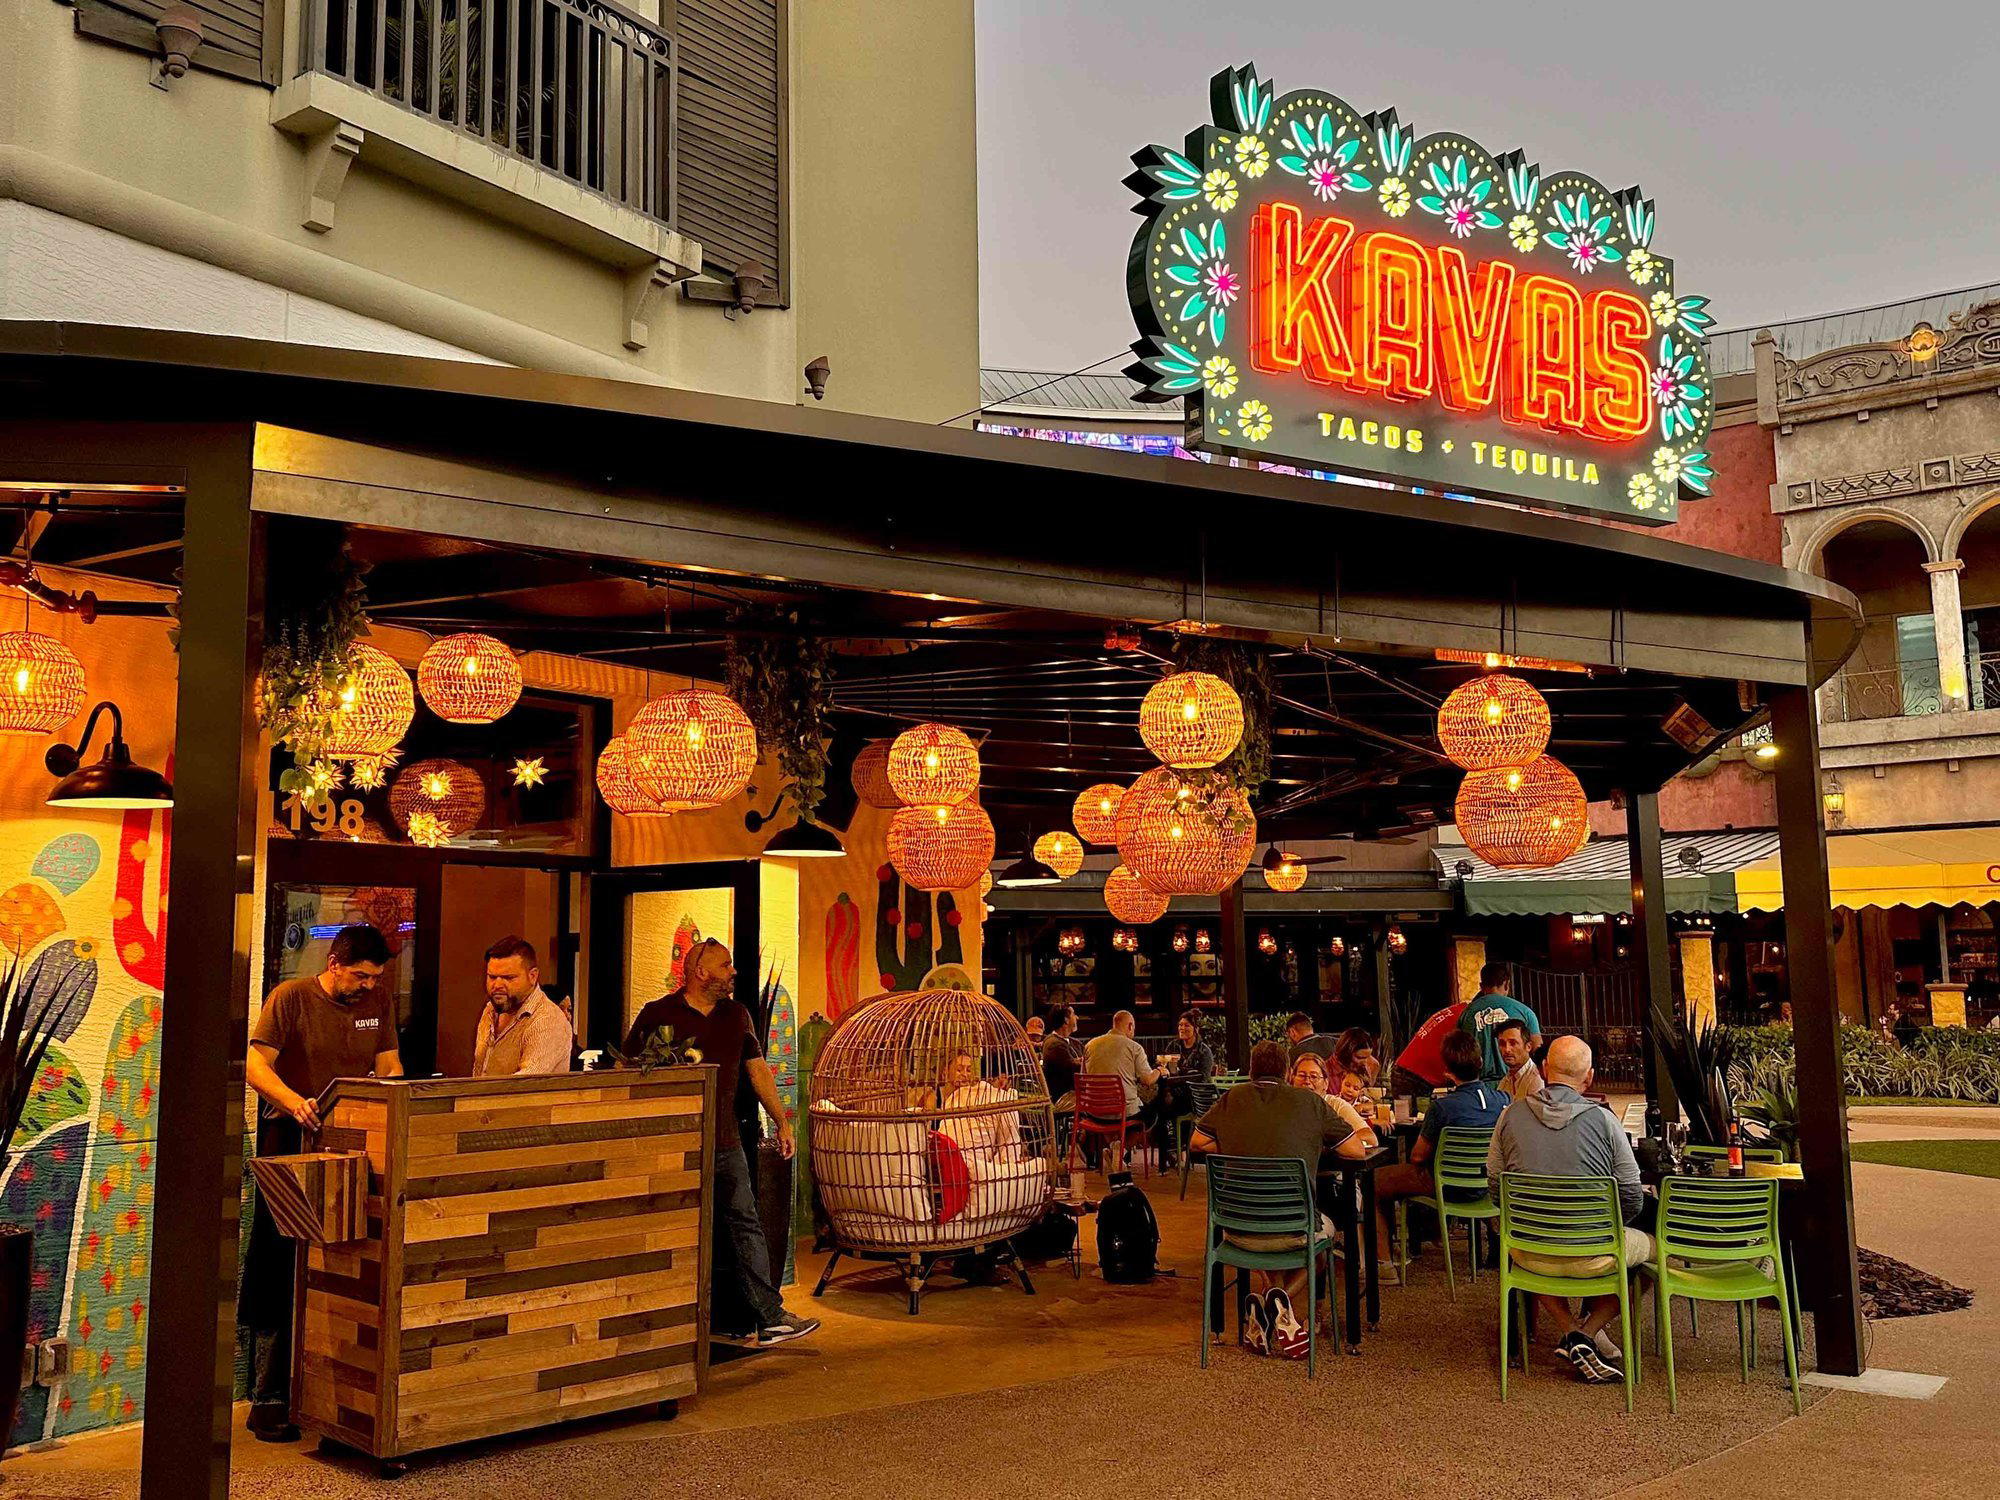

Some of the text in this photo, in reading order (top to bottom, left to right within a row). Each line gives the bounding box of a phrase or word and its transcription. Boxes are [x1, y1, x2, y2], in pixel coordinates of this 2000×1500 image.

[1252, 201, 1652, 439] KAVAS
[1317, 412, 1424, 453] TACOS
[1471, 441, 1600, 485] TEQUILA
[355, 1018, 379, 1028] KAVAS
